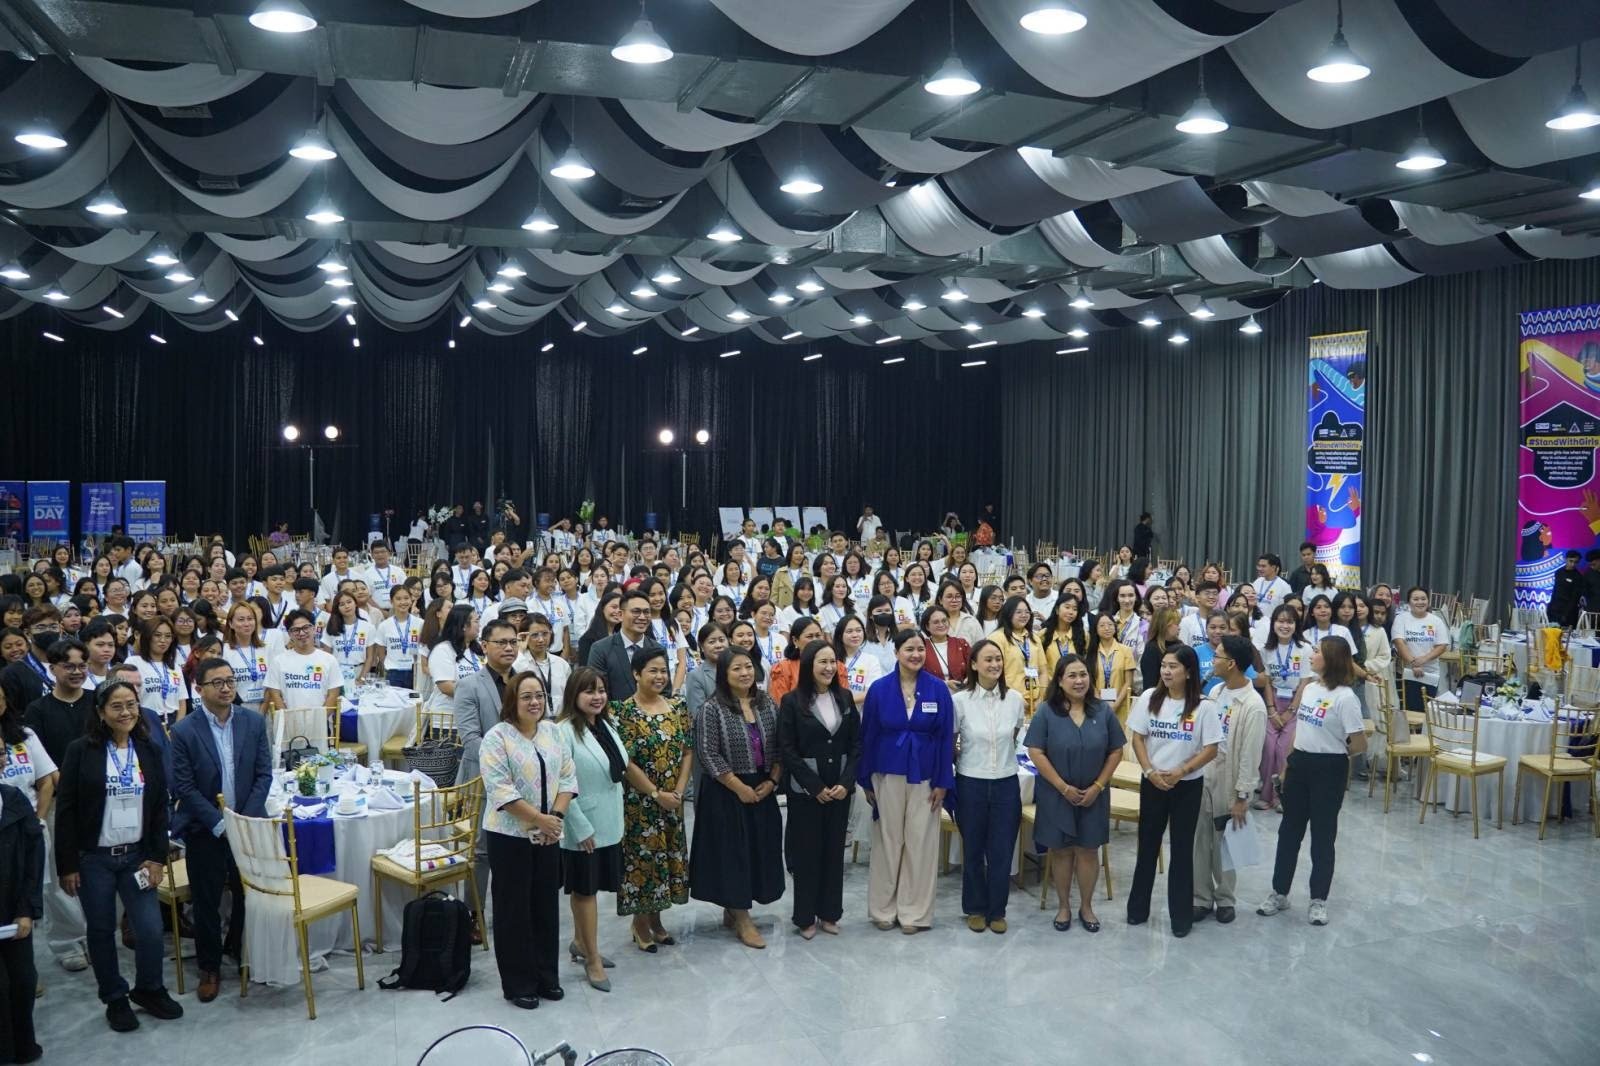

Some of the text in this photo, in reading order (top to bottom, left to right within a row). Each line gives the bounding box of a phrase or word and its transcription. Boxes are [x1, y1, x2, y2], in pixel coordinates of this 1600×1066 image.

[1529, 437, 1599, 446] #StandWithGirls
[130, 498, 160, 506] GIRLS
[34, 508, 65, 519] DAY
[285, 673, 310, 681] Stand
[285, 681, 321, 690] withGirls
[1150, 719, 1179, 729] Stand
[1150, 730, 1192, 741] withGirls
